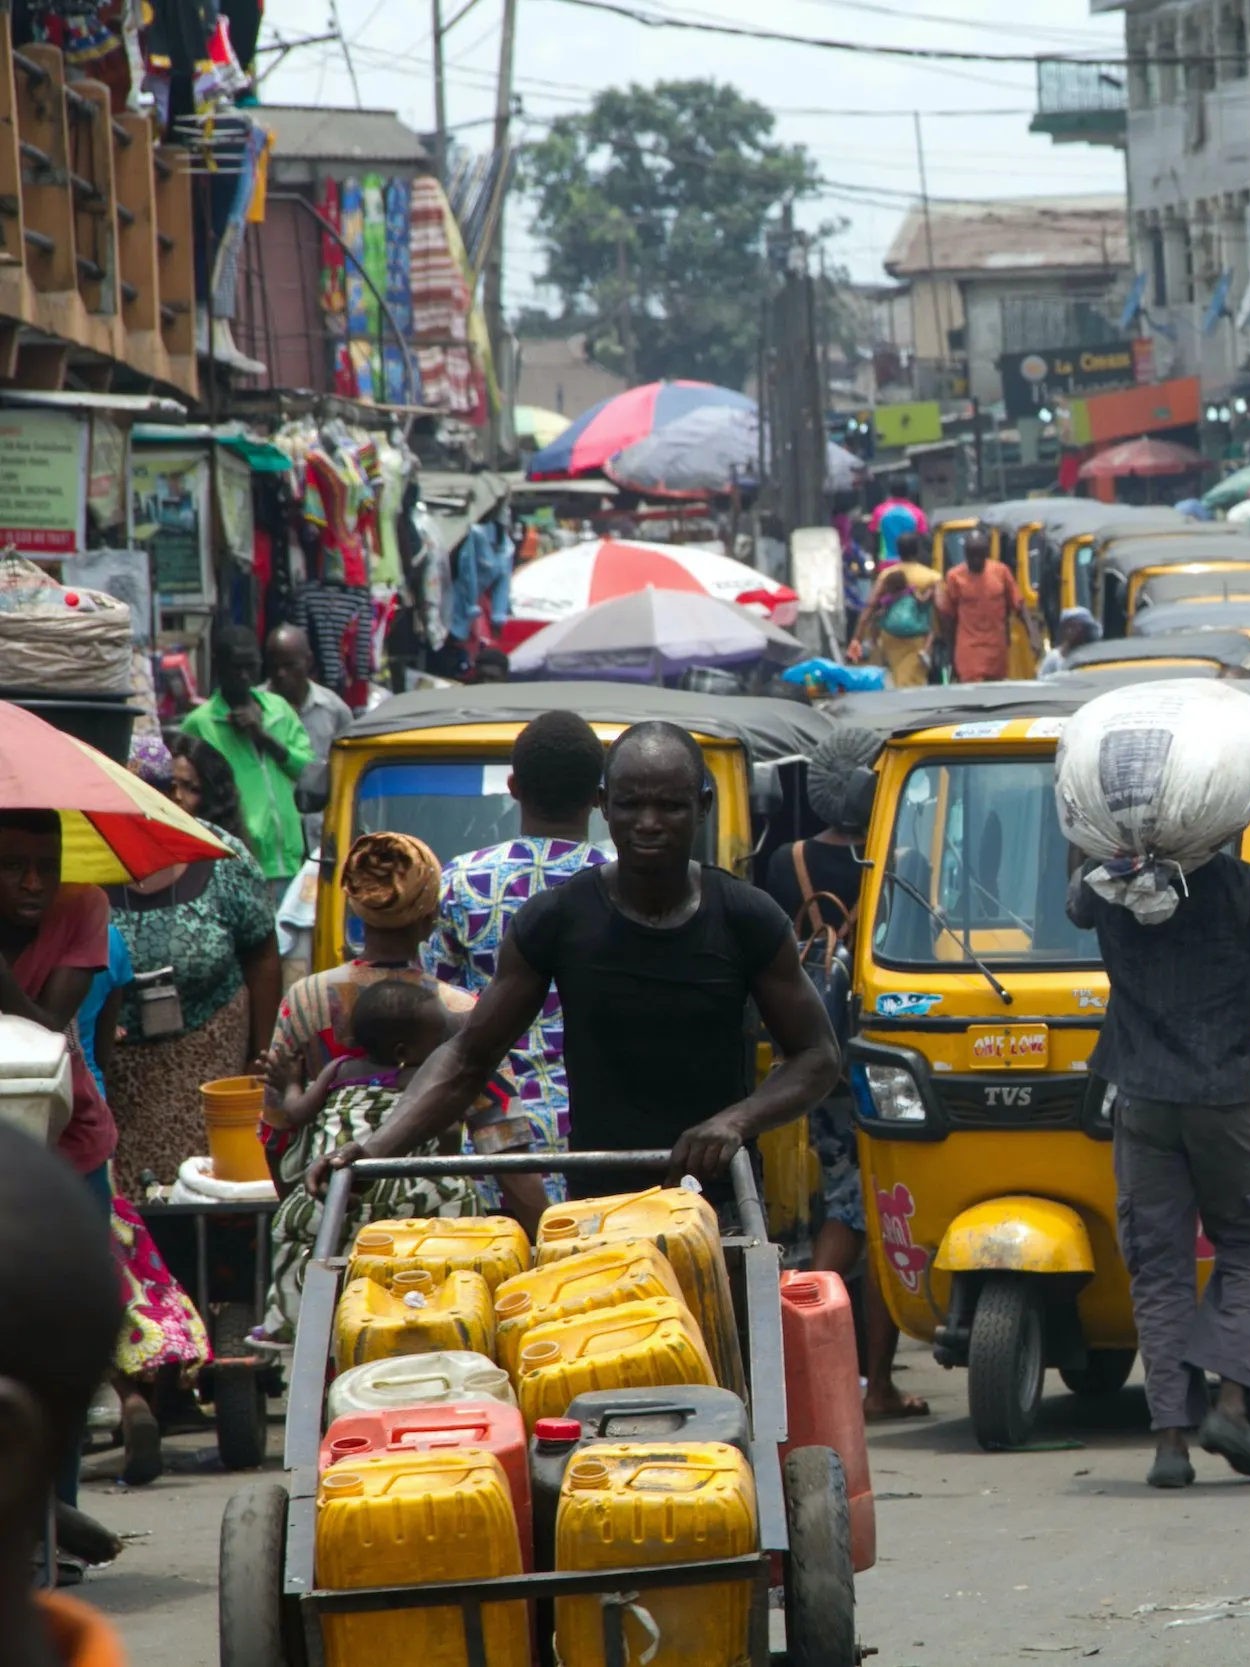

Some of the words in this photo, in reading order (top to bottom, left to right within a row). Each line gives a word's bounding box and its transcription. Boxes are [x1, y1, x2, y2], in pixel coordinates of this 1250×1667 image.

[973, 1034, 1006, 1058] ONE
[1010, 1033, 1047, 1056] LOVE
[984, 1086, 1032, 1106] TVS
